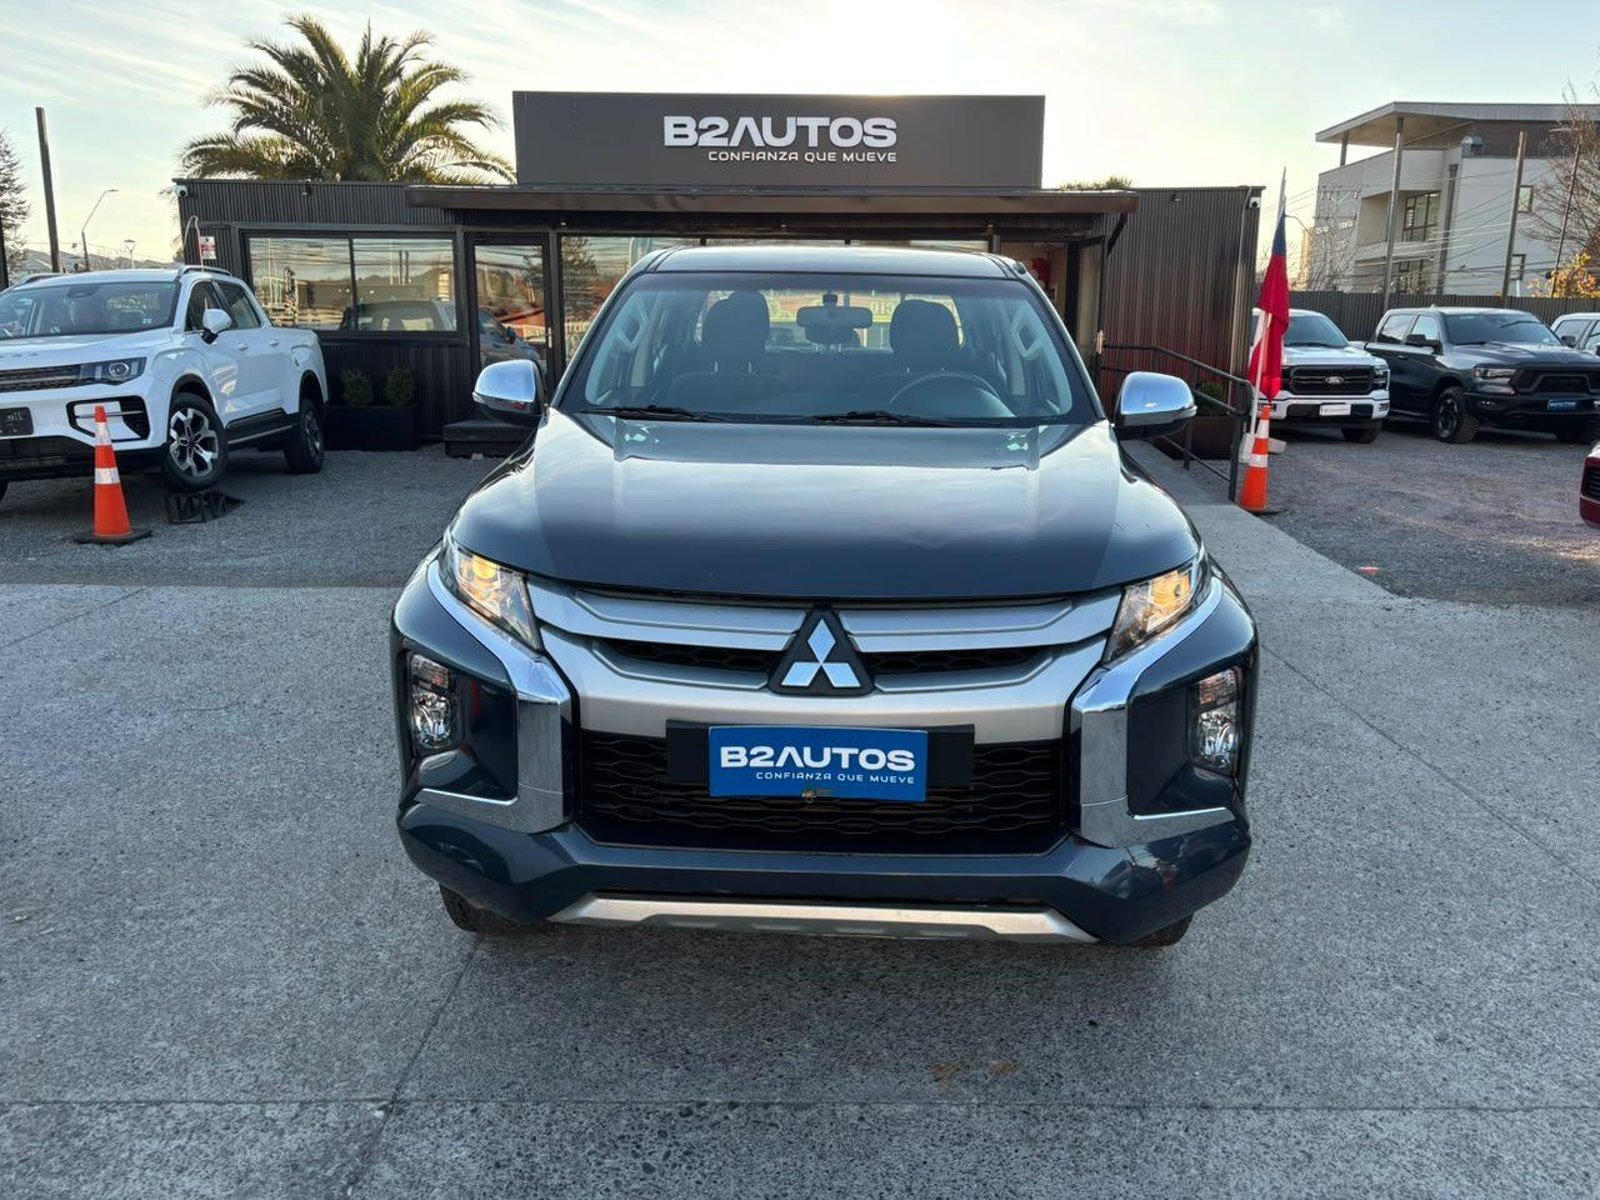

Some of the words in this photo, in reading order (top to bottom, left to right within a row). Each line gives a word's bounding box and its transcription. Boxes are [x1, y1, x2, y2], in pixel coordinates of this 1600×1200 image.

[664, 116, 897, 147] B2AUTOS
[708, 151, 798, 161] CONFIANZA
[804, 152, 837, 163] QUE
[842, 152, 897, 162] MUEVE
[720, 746, 915, 772] B2AUTOS
[756, 772, 832, 780] CONFIANZA
[837, 773, 864, 782] QUE
[870, 775, 915, 784] MUEVE
